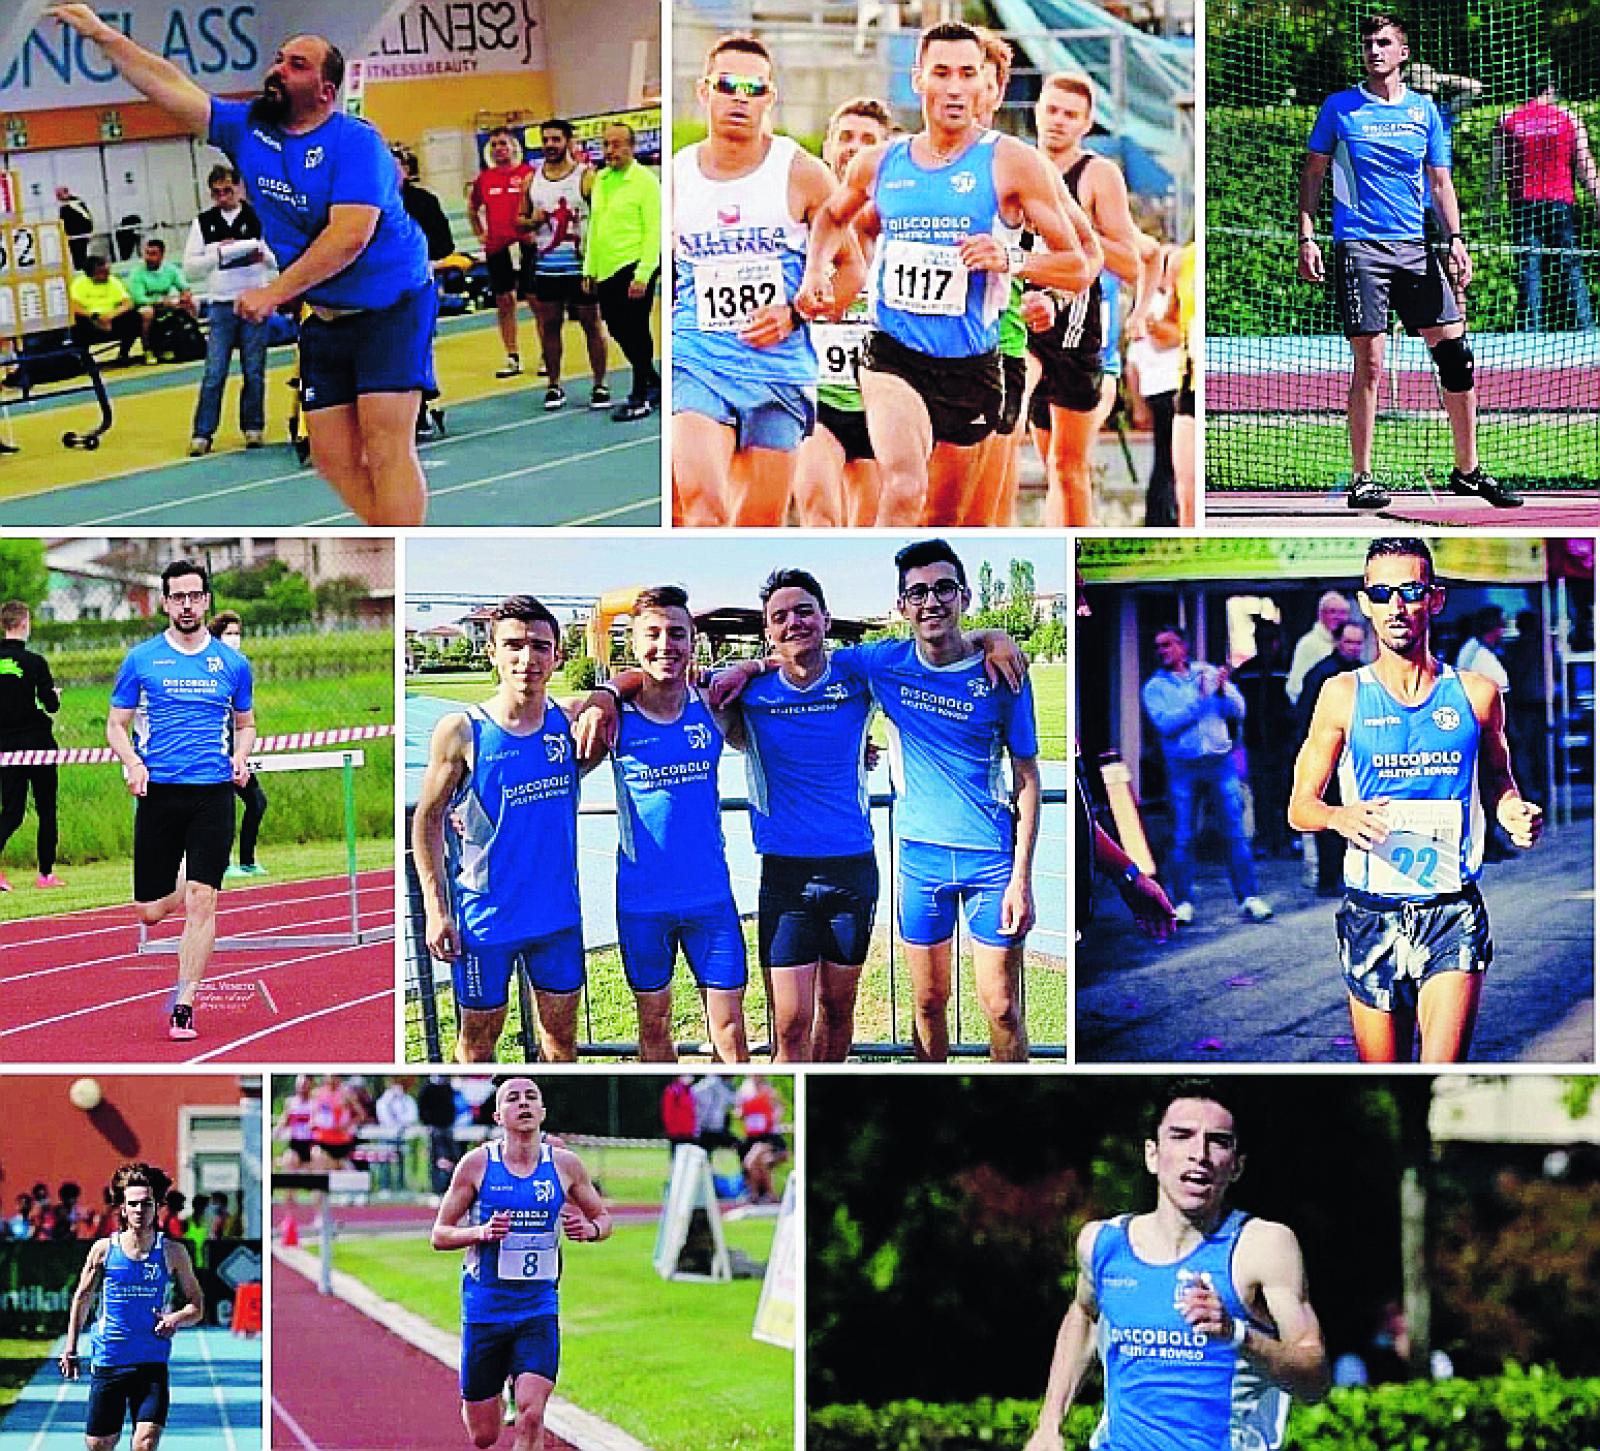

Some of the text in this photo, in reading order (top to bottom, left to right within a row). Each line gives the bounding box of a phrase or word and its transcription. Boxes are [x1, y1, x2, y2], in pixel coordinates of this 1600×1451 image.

[895, 263, 953, 301] 1117
[704, 282, 776, 320] 1382
[900, 685, 974, 713] DISCOBOLO
[640, 760, 710, 780] DISCOBOLO
[1372, 750, 1462, 768] DISCOBOLO
[1391, 846, 1438, 888] 22
[523, 1252, 538, 1277] 8
[1111, 1328, 1208, 1348] DISCOBOLO
